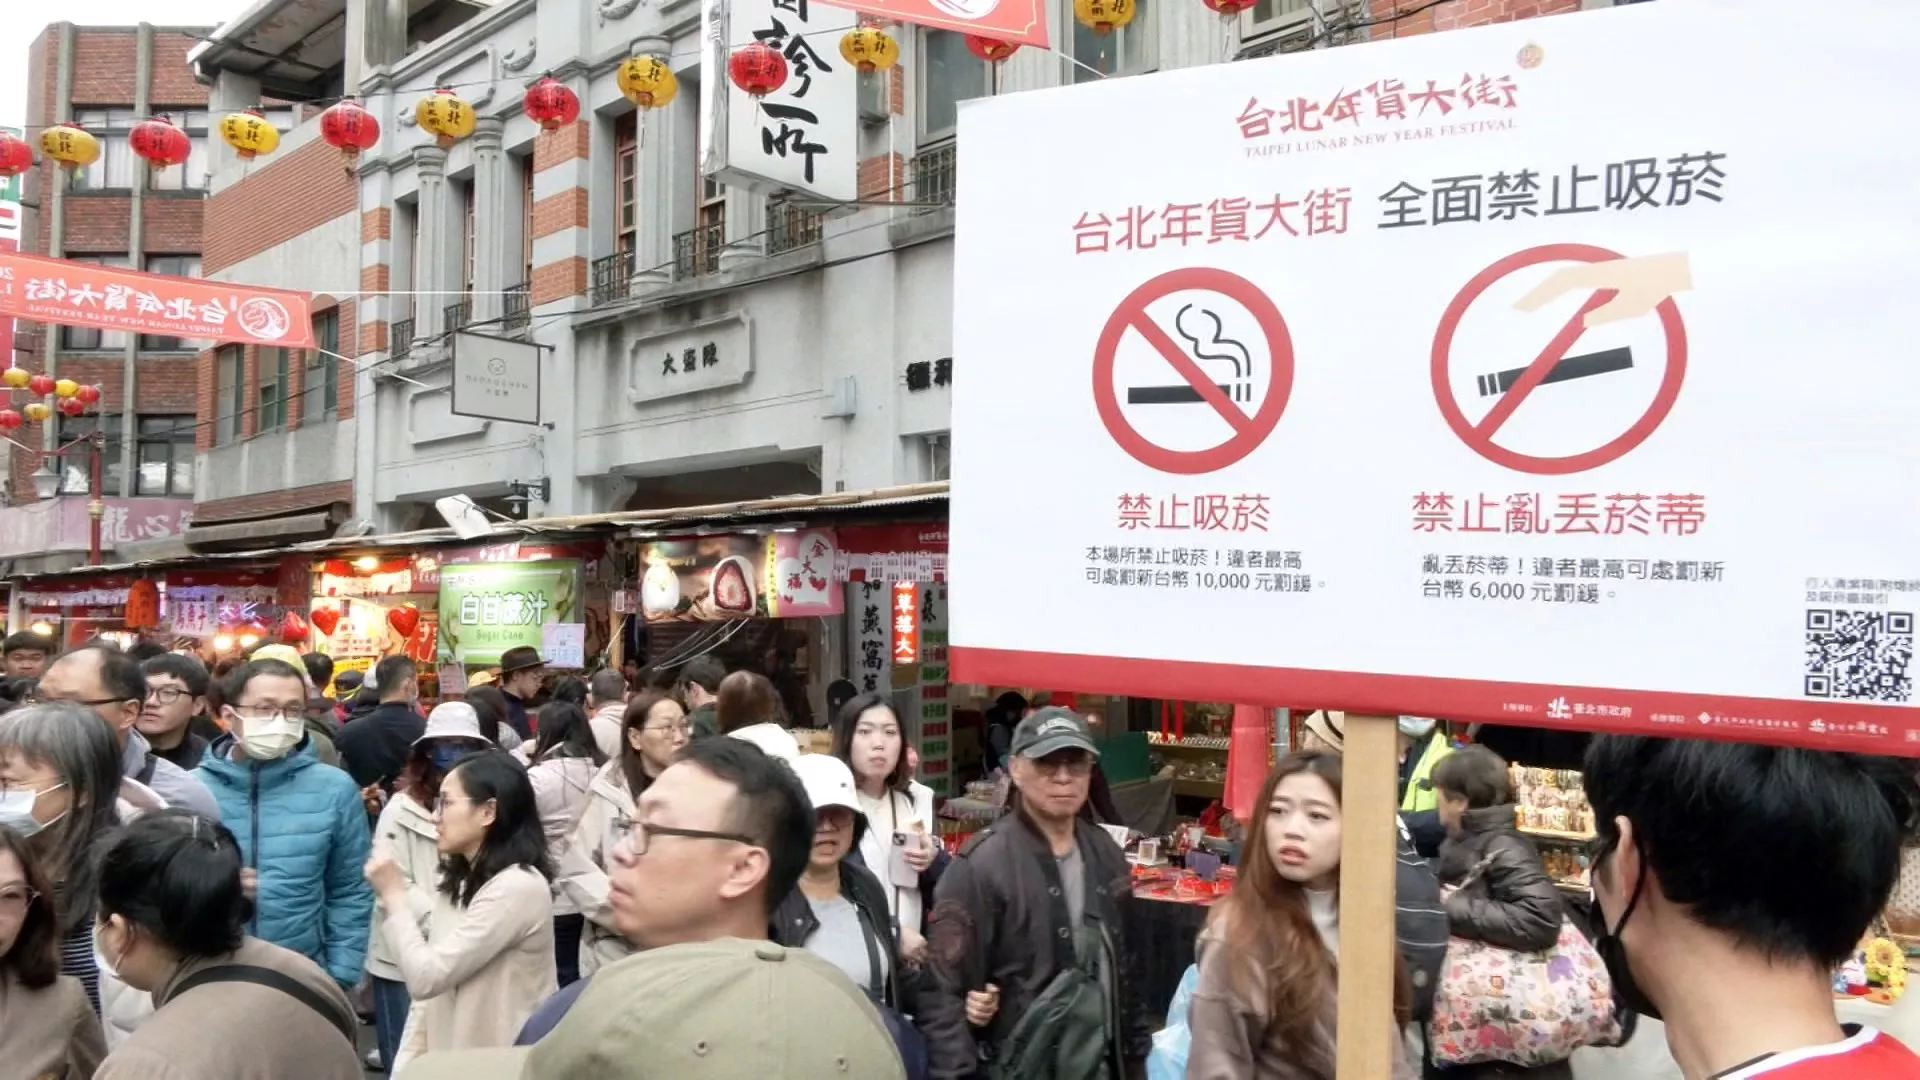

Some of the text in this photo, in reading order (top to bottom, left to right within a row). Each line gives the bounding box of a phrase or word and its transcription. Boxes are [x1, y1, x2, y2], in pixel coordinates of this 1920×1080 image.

[752, 0, 833, 184] 診所
[1235, 72, 1518, 140] 台北年貨大街
[1244, 118, 1518, 159] TAIPEI LUNAR NEW YEAR FESTIVAL
[1071, 151, 1727, 255] 台北年貨大街 全面禁止吸菸
[1117, 493, 1271, 532] 禁止吸菸
[1411, 491, 1707, 536] 禁止亂丟菸蒂
[786, 538, 830, 590] 金大福
[1085, 546, 1302, 570] 本場所禁止吸菸！違者最高
[1195, 572, 1250, 590] 10,000
[1422, 578, 1464, 598] 台幣
[1469, 580, 1526, 601] 6,000
[460, 589, 549, 628] 白甘蔗汁
[476, 629, 524, 641] Sugar Cane
